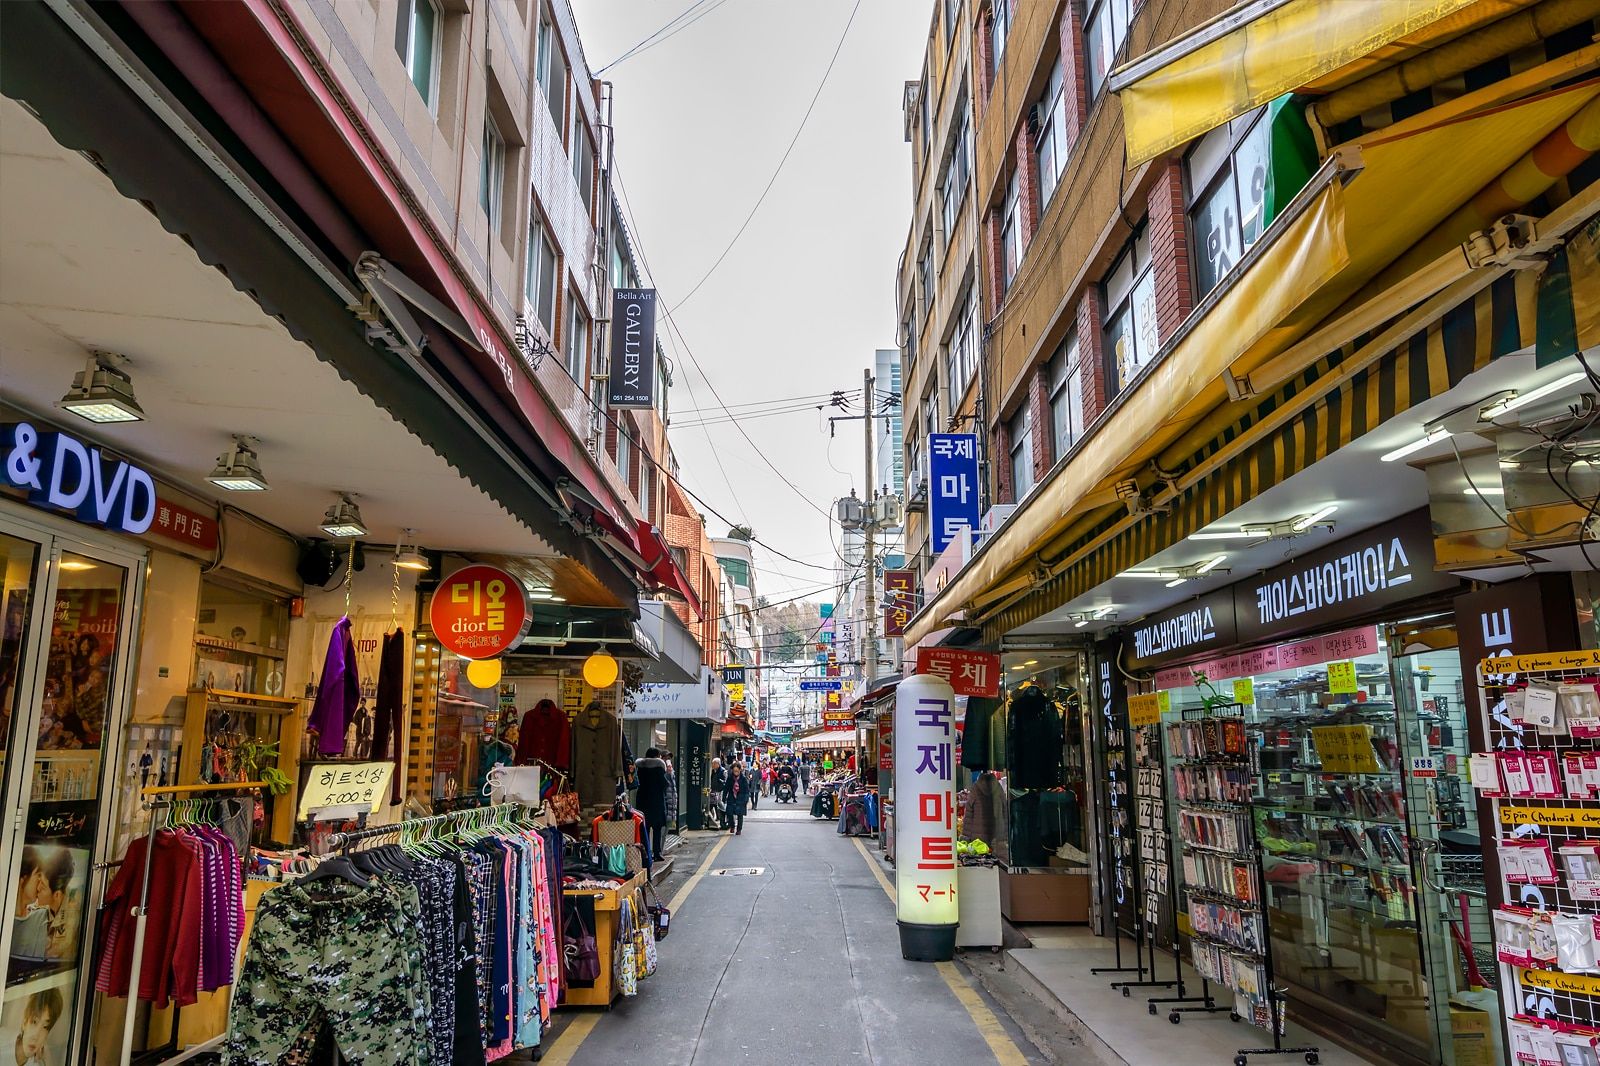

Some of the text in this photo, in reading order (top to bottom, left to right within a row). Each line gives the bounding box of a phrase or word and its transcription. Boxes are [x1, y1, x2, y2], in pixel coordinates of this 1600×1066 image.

[617, 292, 652, 300] Bella Art
[624, 303, 642, 390] GALLERY
[934, 439, 973, 459] 국제
[48, 432, 156, 533] DVD
[1256, 536, 1412, 624] 케이스바이케이스
[451, 579, 506, 631] 디올
[451, 618, 486, 633] dior
[1134, 606, 1216, 659] 케이스바이케이스
[726, 670, 742, 682] JUN
[641, 692, 680, 703] おみやげ
[963, 686, 986, 694] DOLCE
